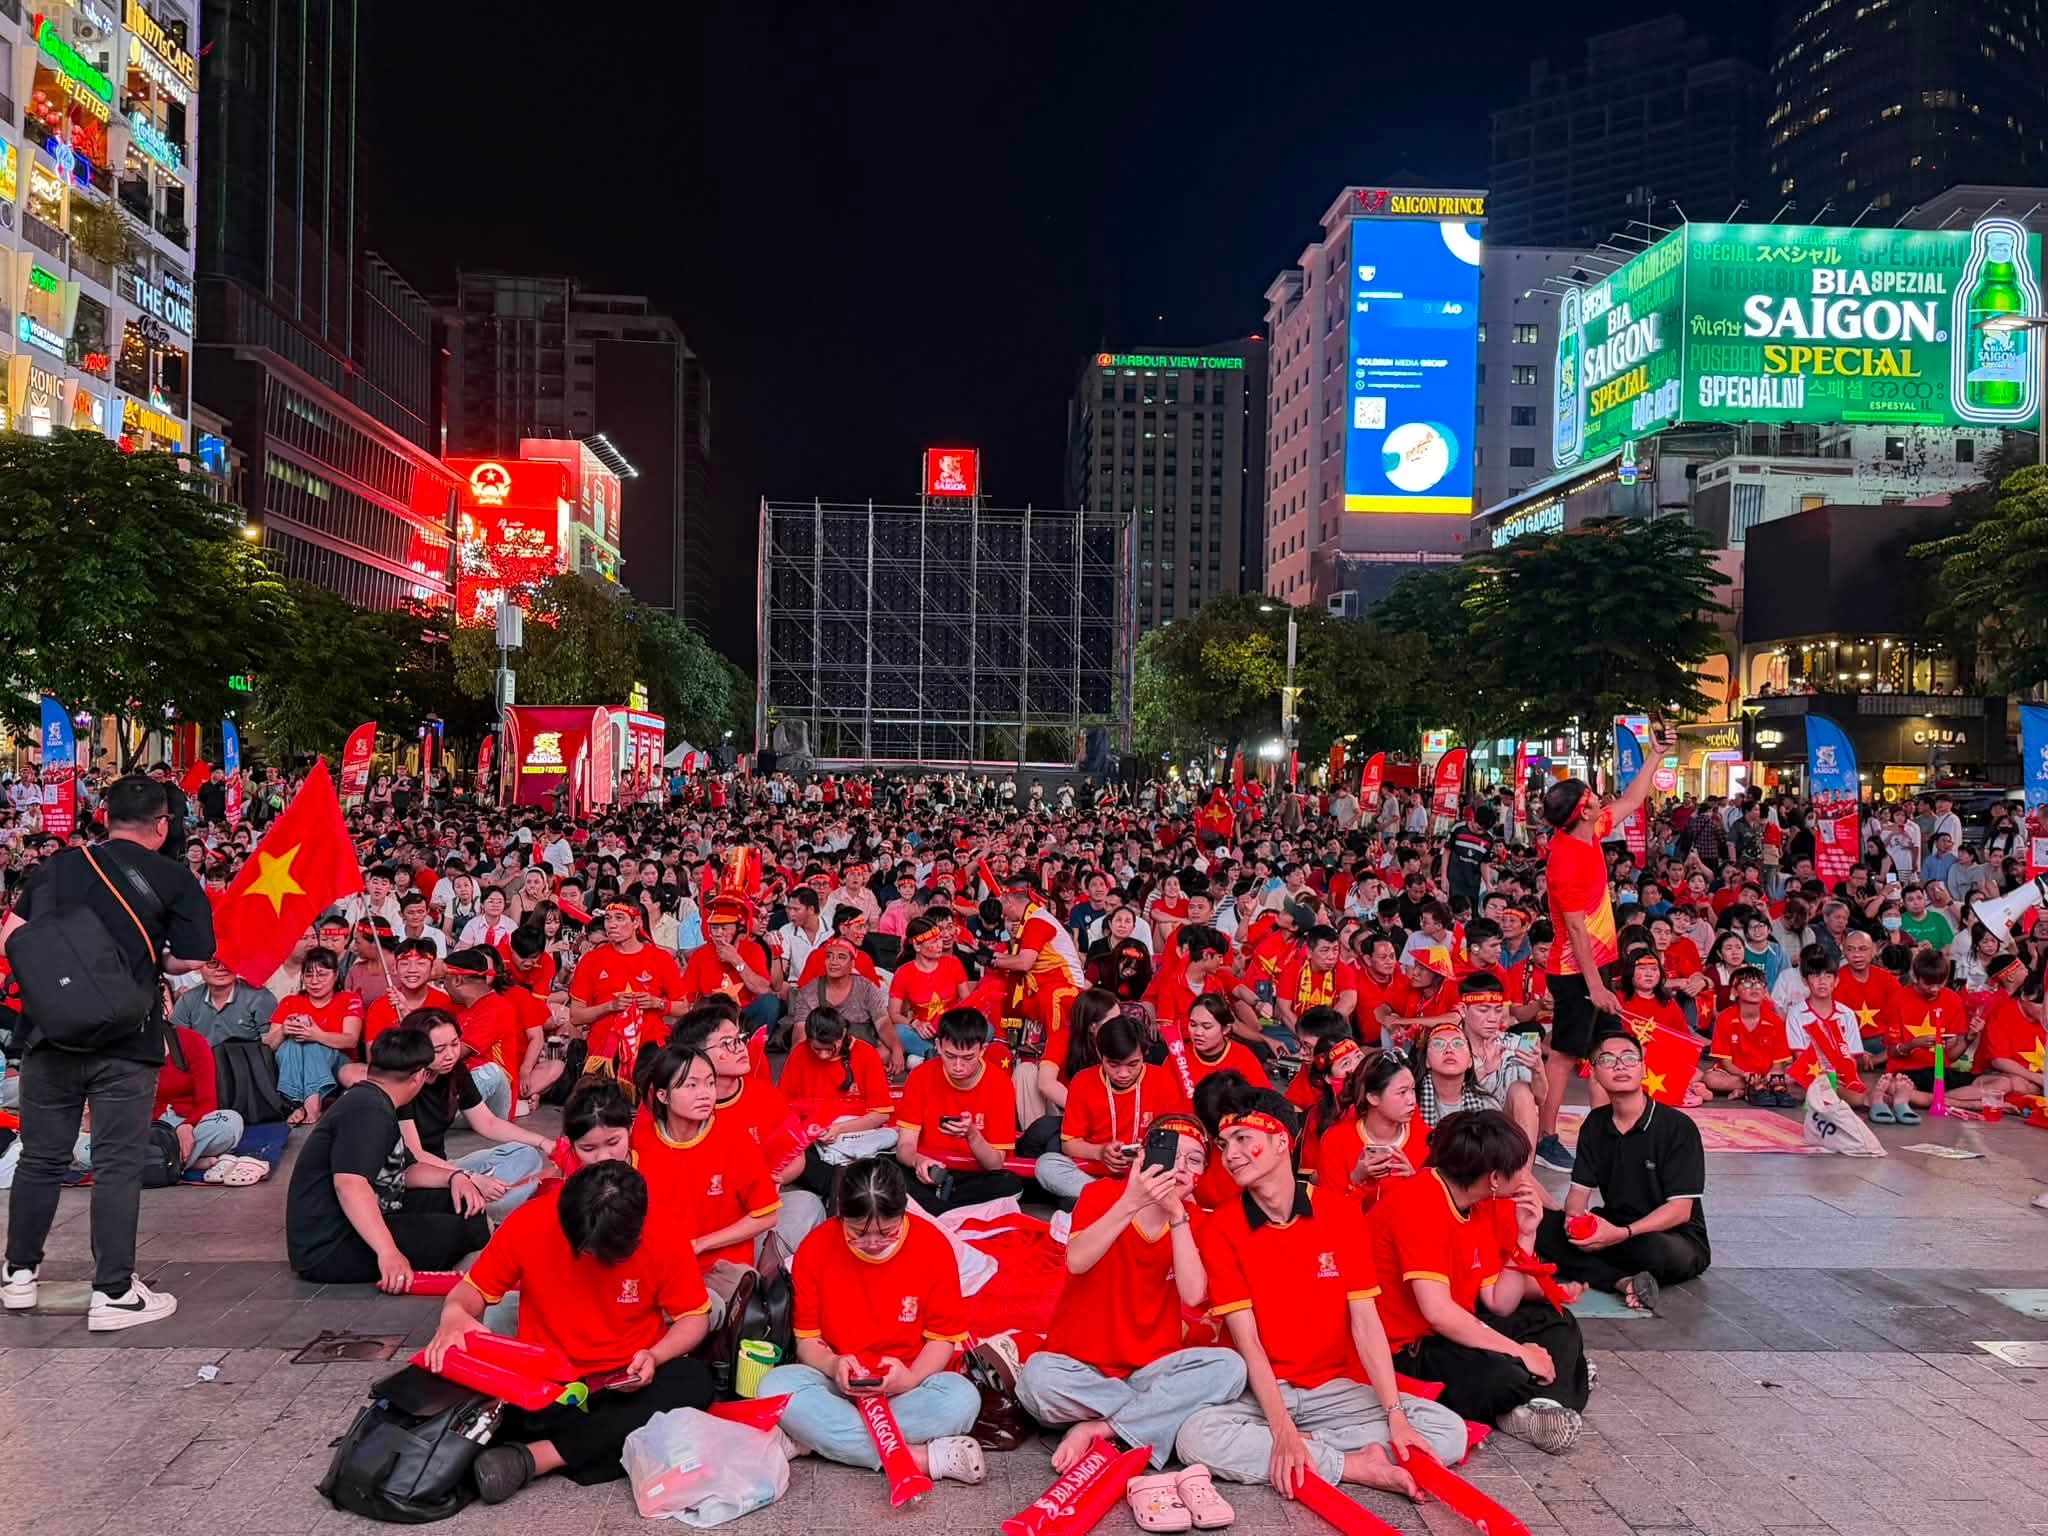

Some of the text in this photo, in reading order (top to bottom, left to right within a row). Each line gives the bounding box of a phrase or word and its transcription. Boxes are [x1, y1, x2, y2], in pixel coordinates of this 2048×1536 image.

[167, 40, 193, 83] CAFE
[55, 67, 110, 123] THE LETTER
[1391, 196, 1485, 215] SAIGON PRINCE
[1756, 245, 1841, 265] スペシャル
[1812, 268, 1873, 296] BIA
[1872, 271, 1947, 294] SPEZIAL
[133, 275, 162, 317] THE
[165, 296, 193, 335] ONE
[1607, 302, 1632, 335] BIA
[1744, 294, 1939, 342] SAIGON
[1690, 313, 1742, 336] พิเศษ
[1112, 355, 1243, 369] HARBOUR VIEW TOWER
[1395, 359, 1419, 367] MEDIA
[1584, 312, 1657, 387] SAIGON
[1690, 343, 1761, 372] POSEBEN
[1764, 345, 1922, 378] SPECIAL
[1978, 351, 2017, 362] SAIGON
[30, 366, 64, 400] KONIC
[1590, 364, 1651, 417] SPECIAL
[1699, 373, 1806, 408] SPECIÁLNÍ
[1869, 400, 1917, 410] ESPESYAL
[140, 408, 183, 442] DOWNTOWN
[1491, 503, 1565, 550] SAIGON GARDEN
[1914, 729, 1967, 744] CHUA
[867, 1405, 901, 1460] SAIGON
[1054, 1450, 1108, 1505] BIA SAIGON
